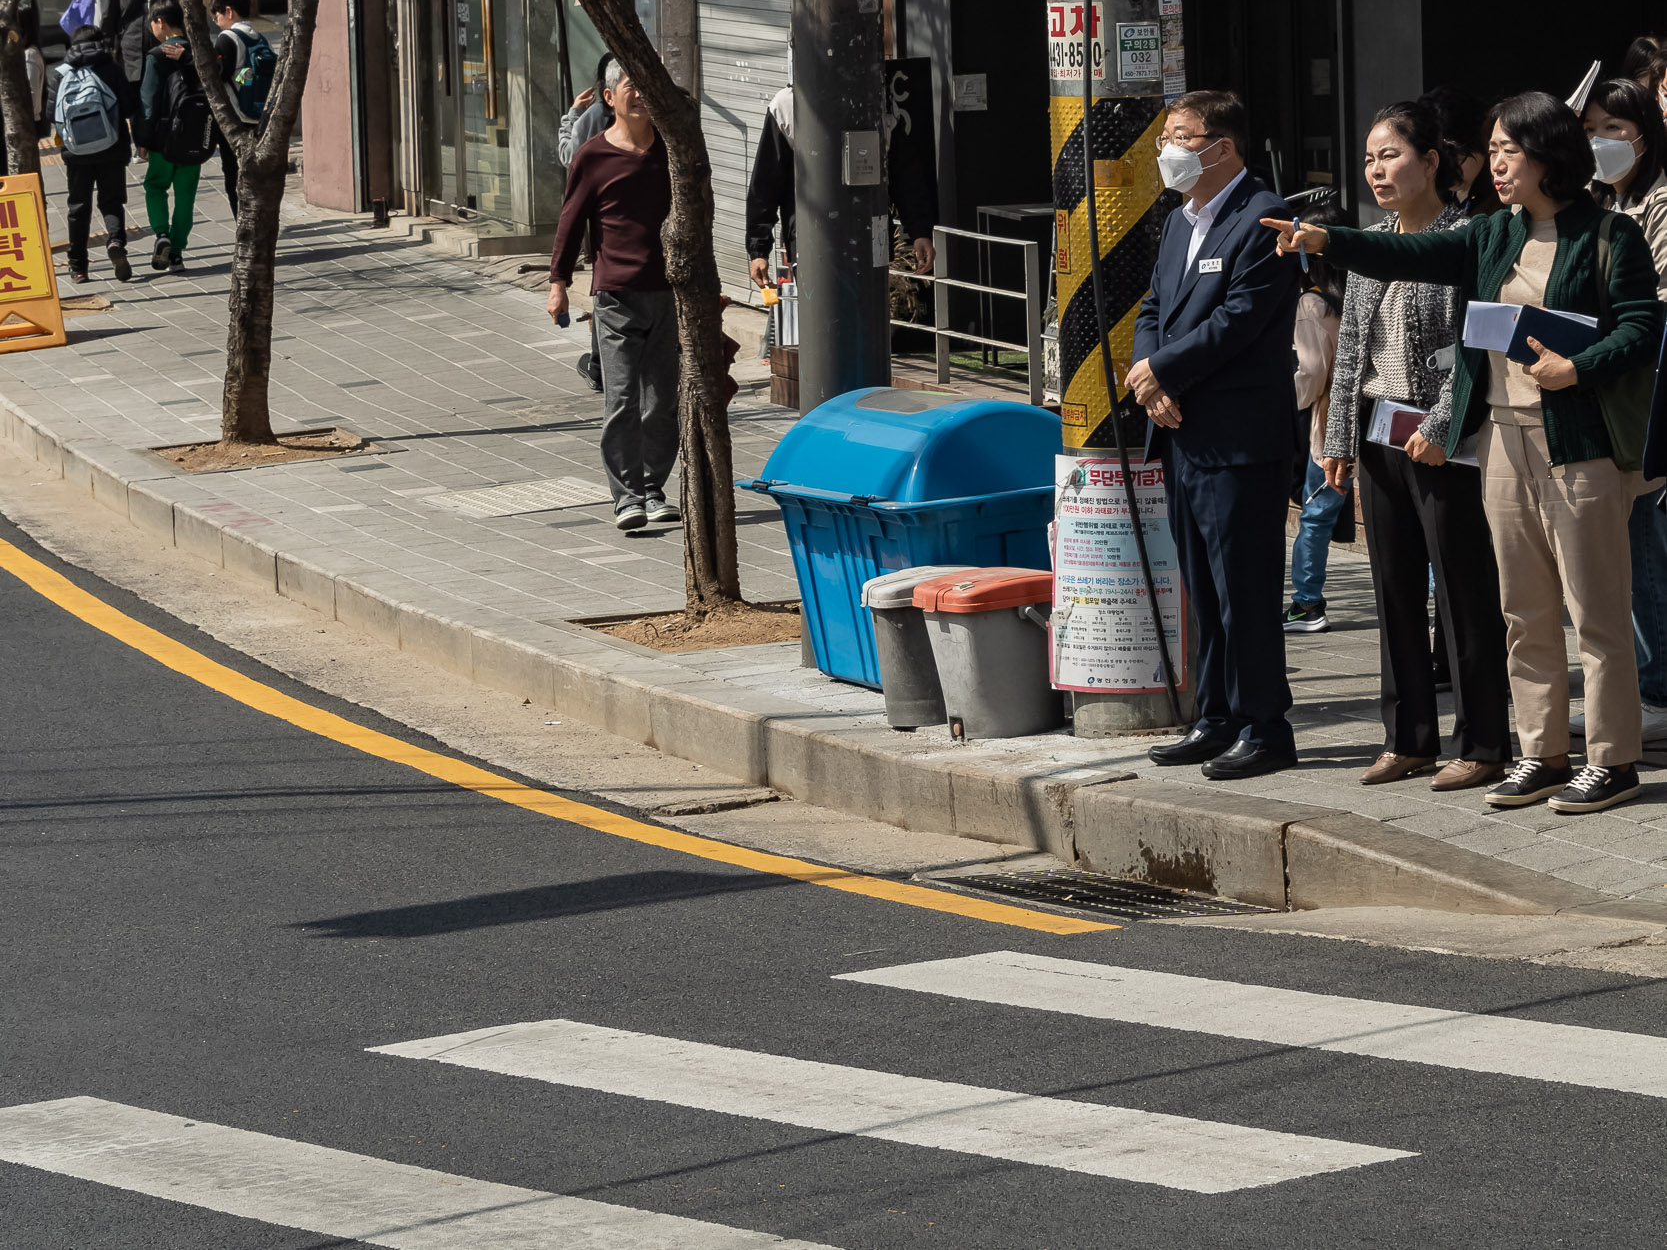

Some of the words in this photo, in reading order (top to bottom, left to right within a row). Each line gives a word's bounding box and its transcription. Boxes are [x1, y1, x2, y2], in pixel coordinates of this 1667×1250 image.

[1124, 39, 1156, 50] 구의2동
[1130, 52, 1152, 63] 032
[1081, 506, 1093, 514] 이하
[1095, 507, 1119, 515] 과태료가
[1077, 576, 1094, 585] 쓰레기
[1095, 577, 1116, 586] 버리는
[1117, 577, 1140, 587] 장소가
